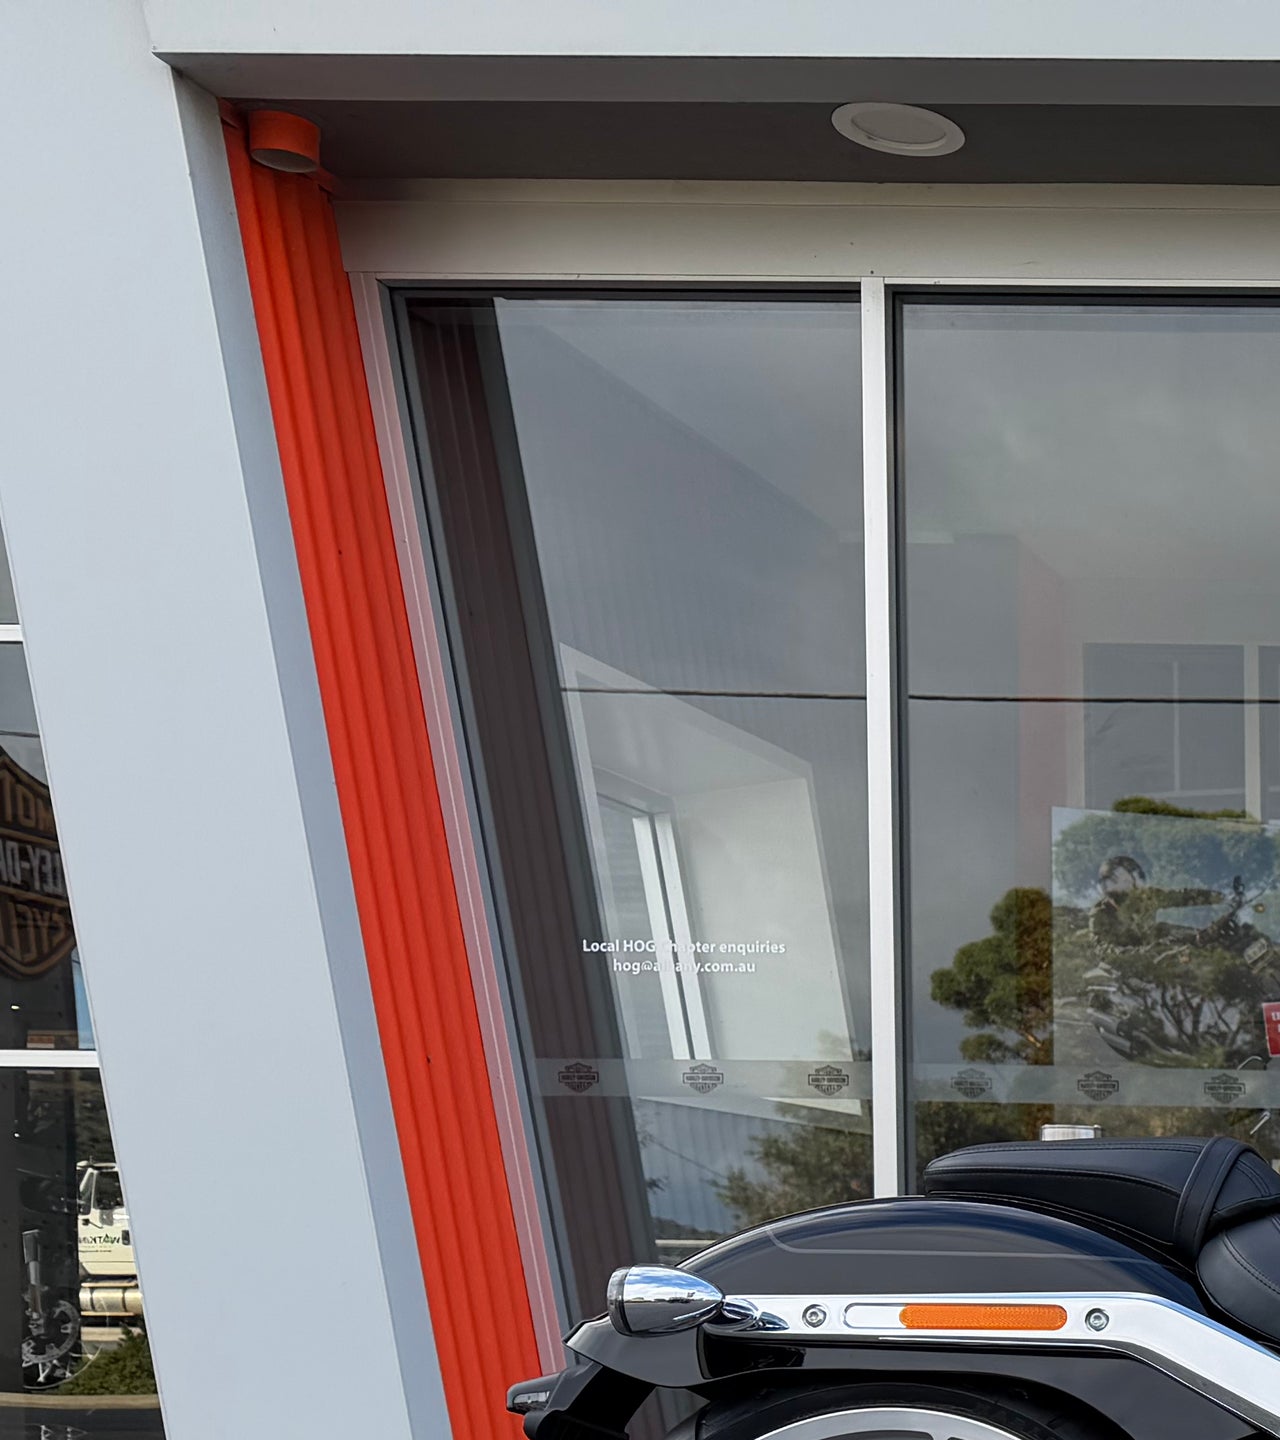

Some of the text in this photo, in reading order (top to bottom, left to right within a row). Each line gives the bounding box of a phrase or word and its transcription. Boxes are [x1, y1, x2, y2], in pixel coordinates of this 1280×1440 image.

[582, 939, 620, 952] Local
[623, 940, 656, 952] HOG
[719, 940, 786, 956] enquiries
